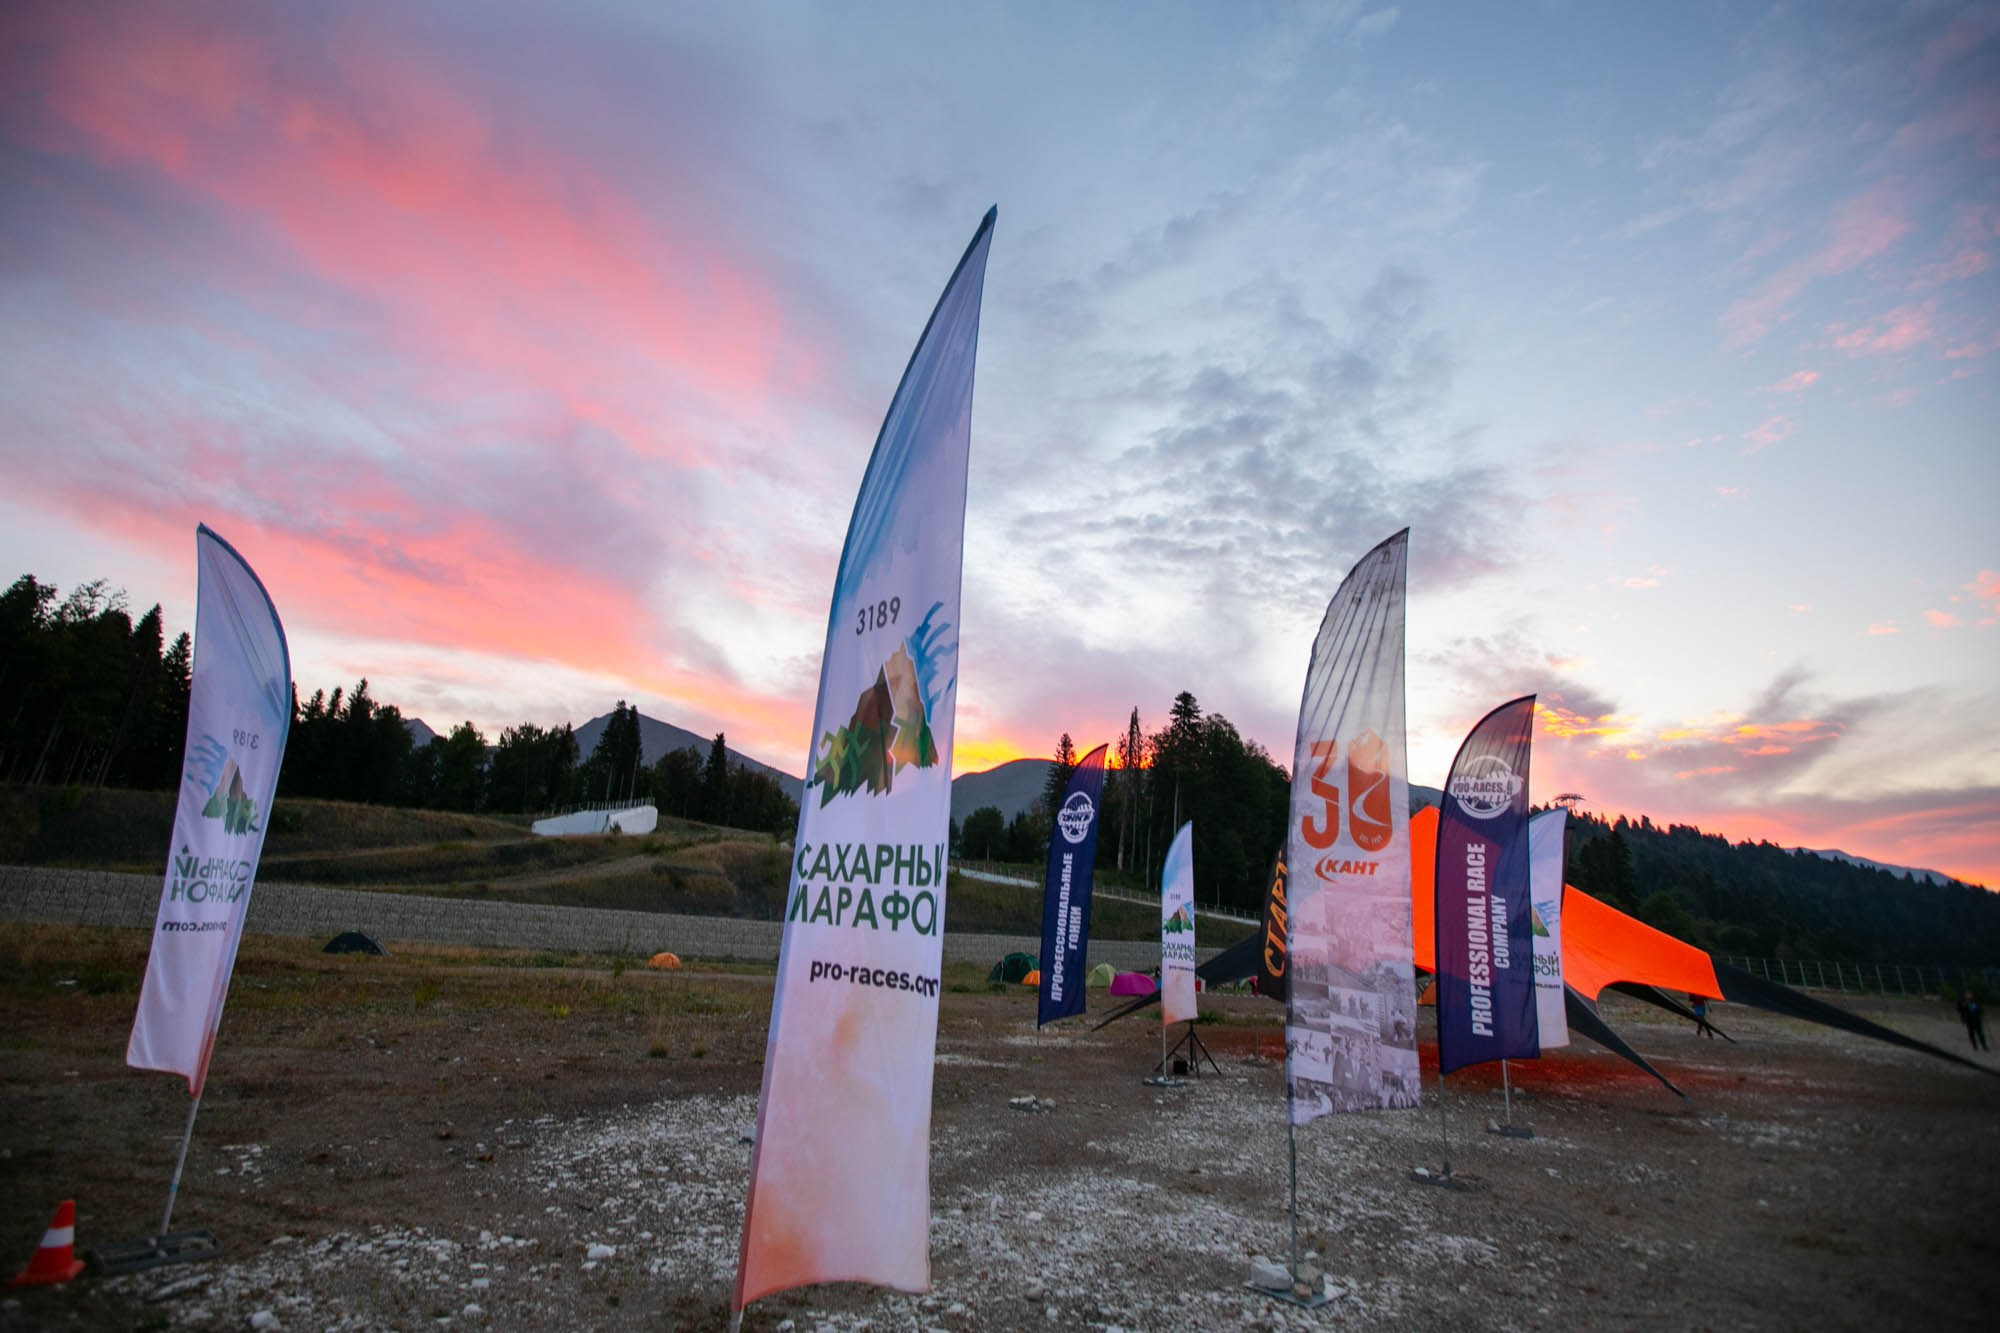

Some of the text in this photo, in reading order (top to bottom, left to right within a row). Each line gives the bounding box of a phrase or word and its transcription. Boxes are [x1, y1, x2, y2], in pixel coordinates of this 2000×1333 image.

[856, 596, 901, 636] 3189
[797, 843, 945, 888] САХАРНЫ
[1051, 853, 1073, 1002] ПРОФЕССИОНАЛЬНЫЕ
[1068, 906, 1083, 950] ГОНКИ
[1467, 843, 1494, 1037] PROFESSIONAL RACE
[1491, 895, 1511, 968] COMPANY
